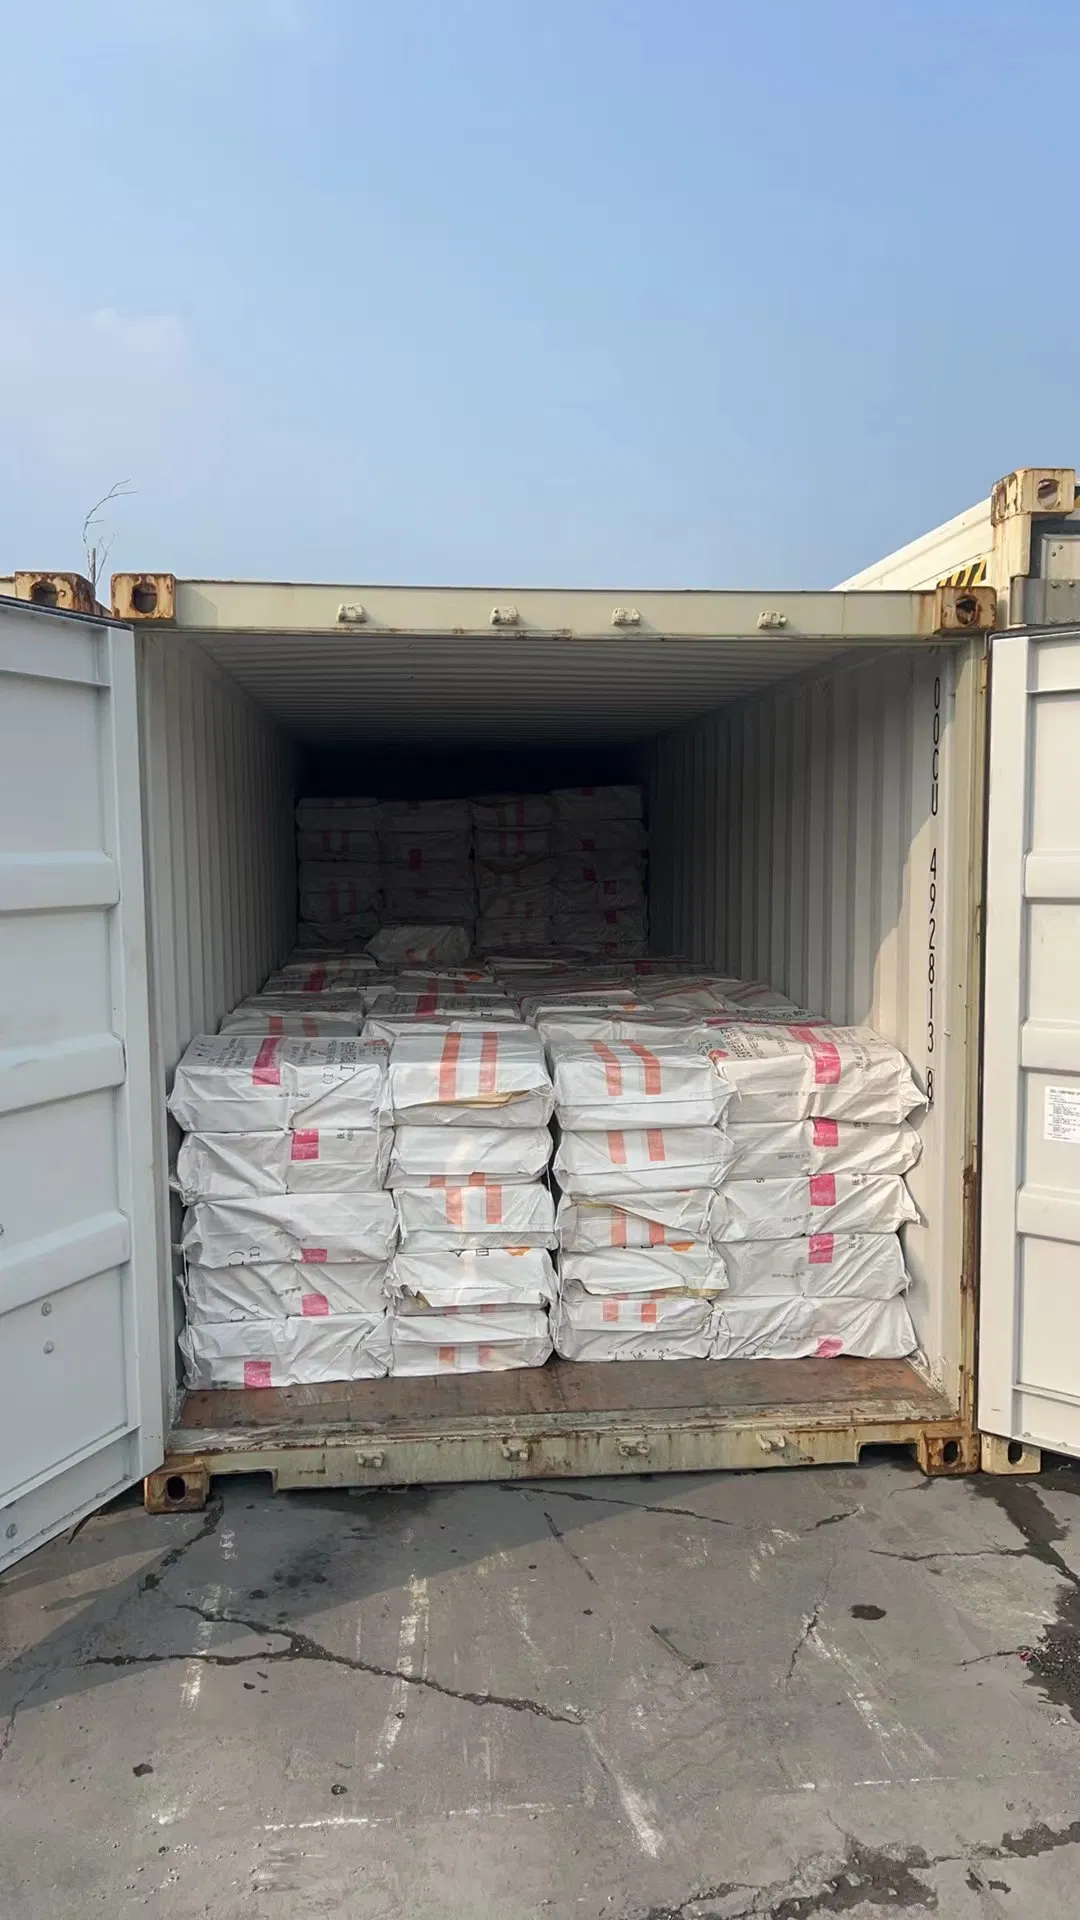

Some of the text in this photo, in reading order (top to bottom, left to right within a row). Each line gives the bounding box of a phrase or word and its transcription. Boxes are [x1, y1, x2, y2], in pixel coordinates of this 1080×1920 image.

[927, 676, 940, 1101] OOCU 492813 8
